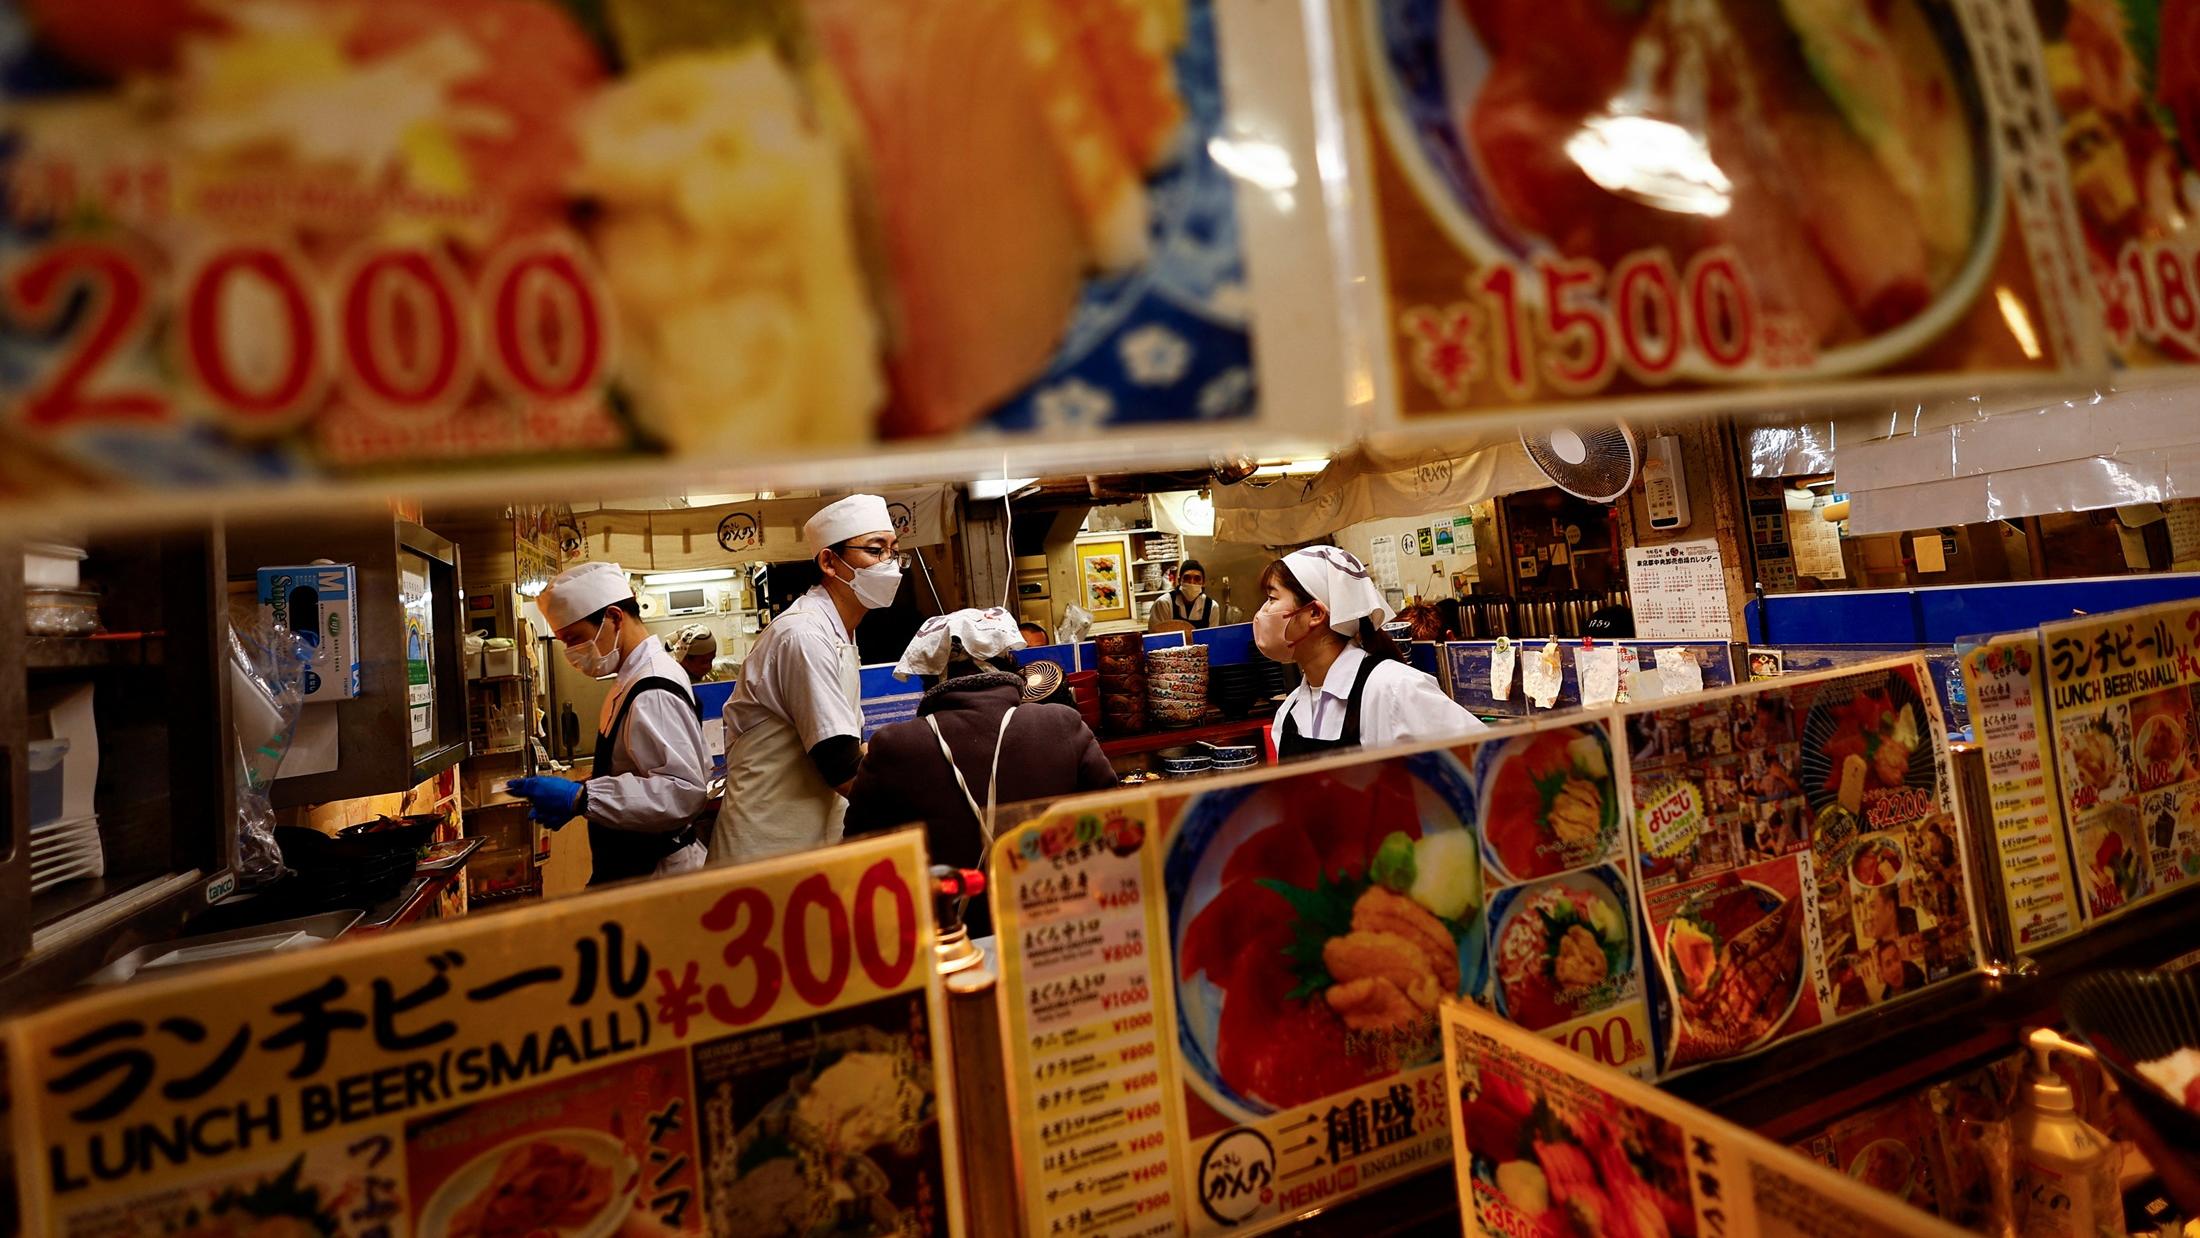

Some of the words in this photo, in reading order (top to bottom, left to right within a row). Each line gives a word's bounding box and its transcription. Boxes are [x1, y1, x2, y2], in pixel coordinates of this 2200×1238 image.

[11, 246, 603, 429] 2000
[1412, 258, 1755, 398] ¥1500
[2096, 247, 2200, 346] ¥18
[318, 571, 345, 593] M
[1588, 619, 1611, 629] 1759
[2052, 619, 2175, 681] ランチビール
[2054, 679, 2102, 710] LUNCH
[2103, 660, 2178, 699] BEER(SMALL)
[1868, 787, 1929, 829] ¥2200
[656, 859, 917, 1038] ¥300
[46, 921, 651, 1122] ランチビール
[50, 1094, 281, 1193] LUNCH
[300, 1002, 651, 1135] BEER(SMALL)
[1278, 1083, 1418, 1181] 三種盛
[646, 1100, 692, 1228] メンマ
[1279, 1175, 1337, 1212] MENU
